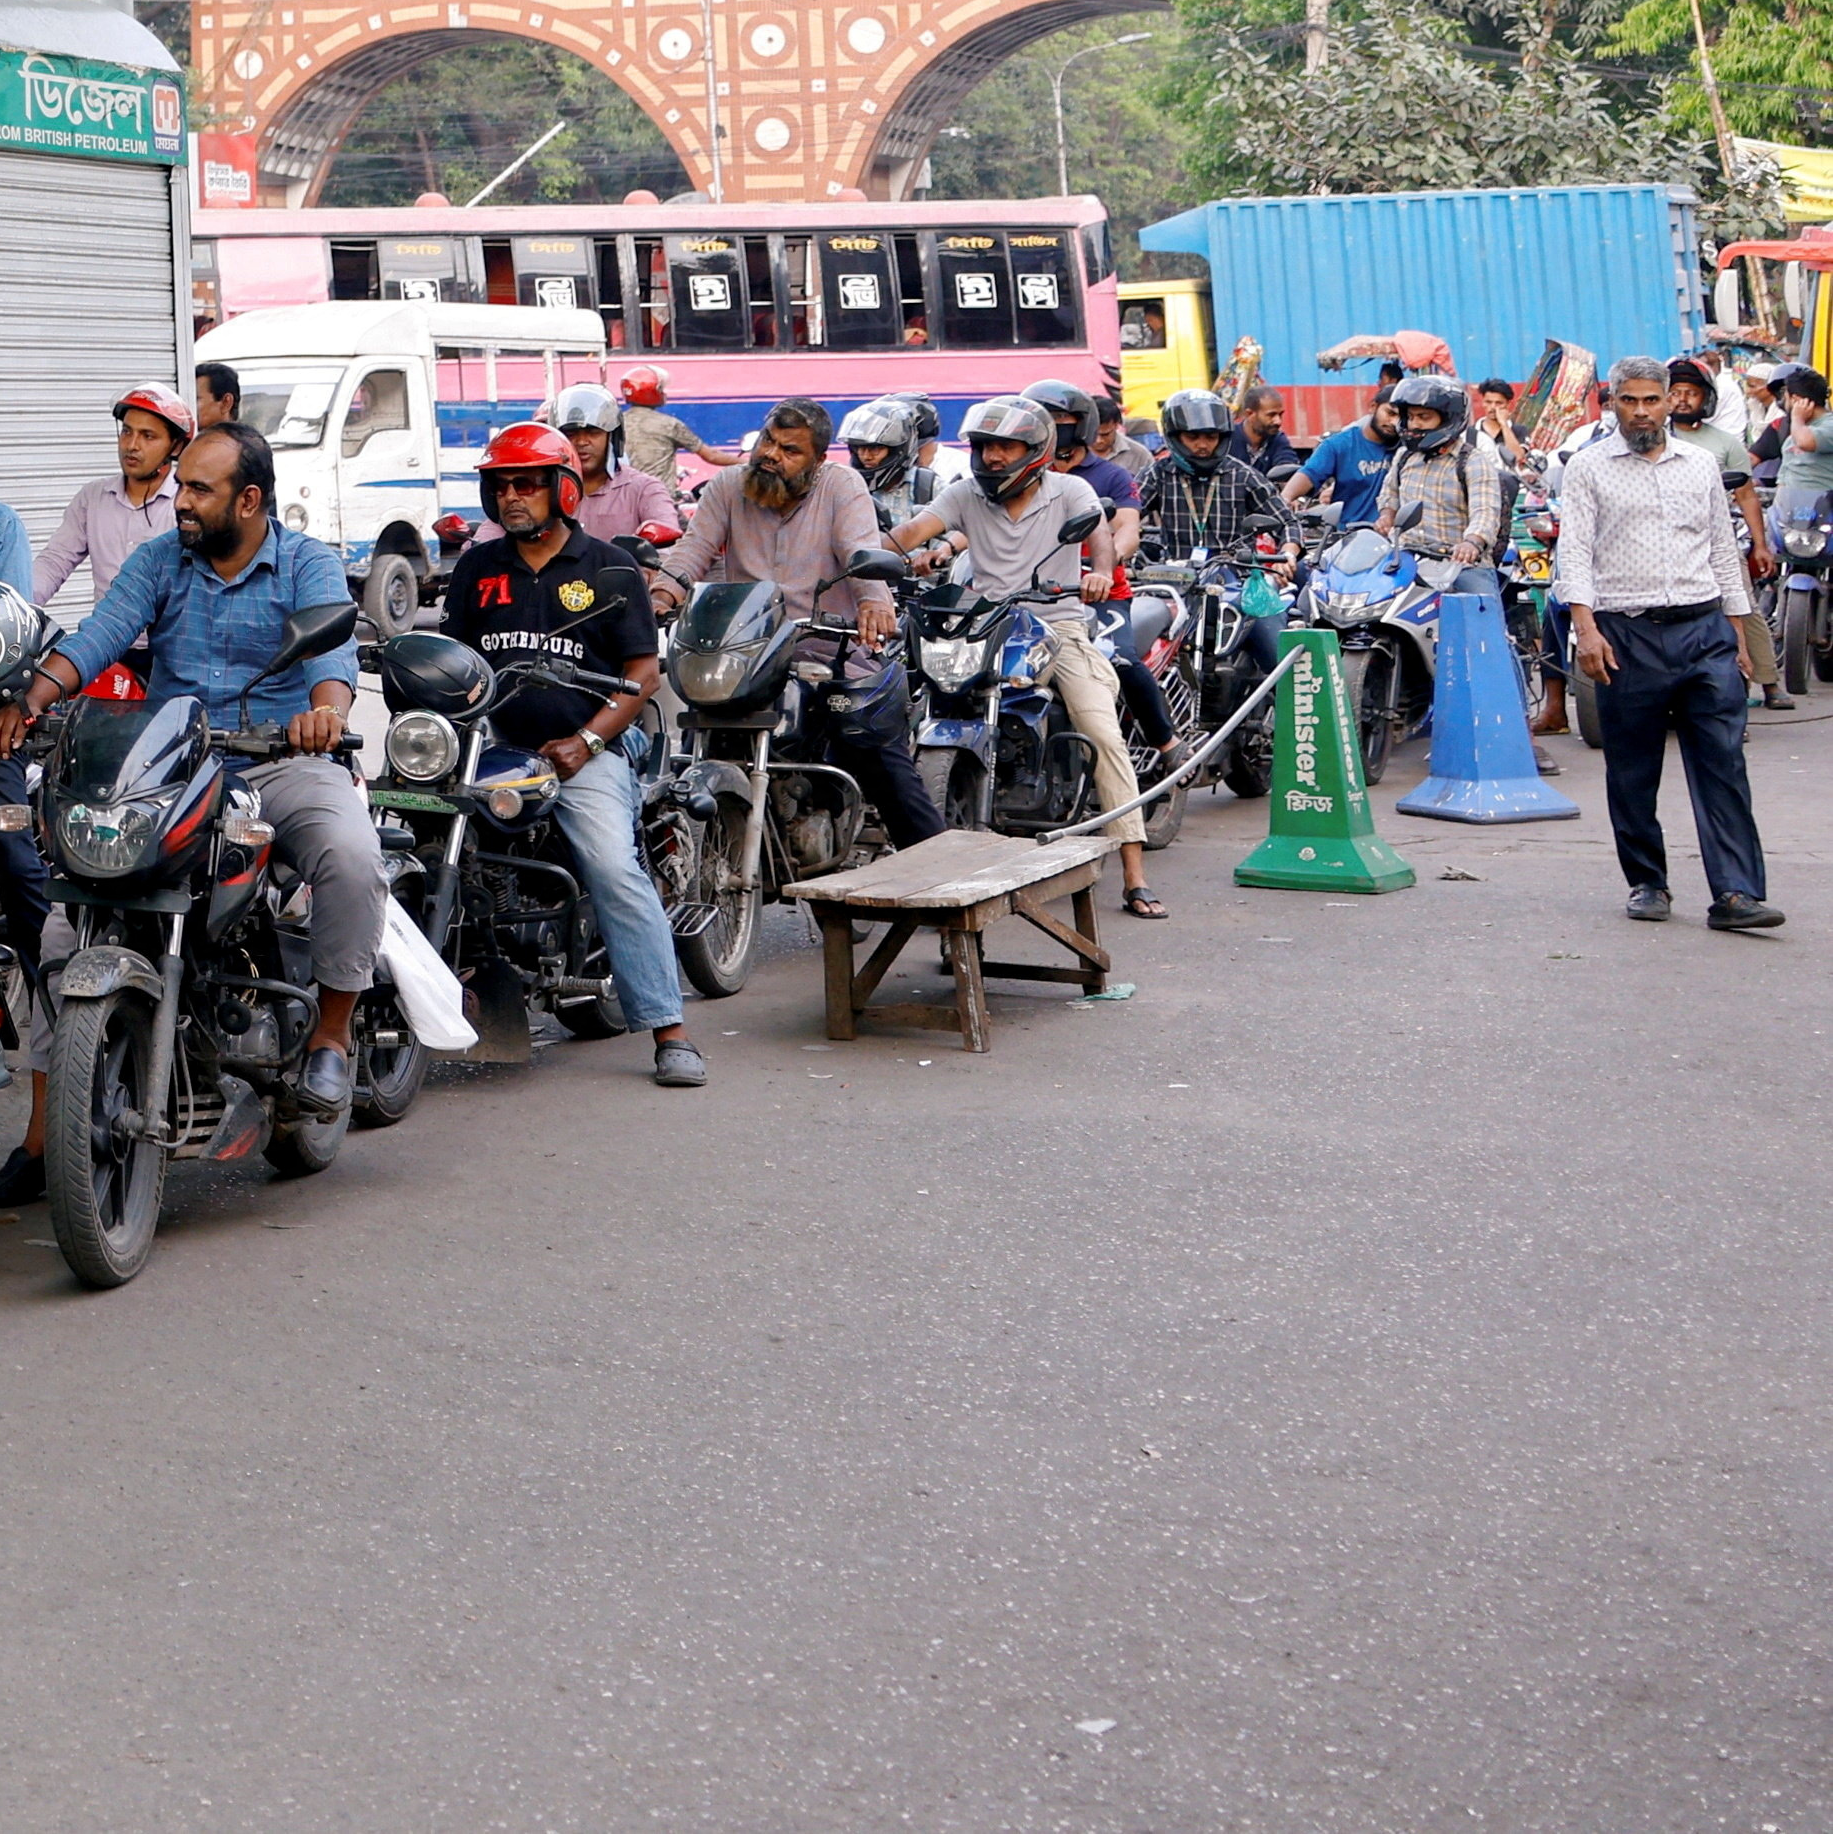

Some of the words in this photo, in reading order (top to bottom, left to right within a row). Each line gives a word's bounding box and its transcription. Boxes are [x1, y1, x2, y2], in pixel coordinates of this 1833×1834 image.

[18, 55, 149, 135] ডিজেল
[24, 127, 72, 147] BRITISH
[74, 133, 148, 155] PETROLEUM
[154, 136, 180, 151] মেঘনা
[477, 573, 514, 609] 71
[480, 631, 585, 660] GOTHENBURG
[111, 674, 126, 697] Hero
[1293, 651, 1324, 787] minister
[1284, 789, 1333, 813] ফ্রিজ
